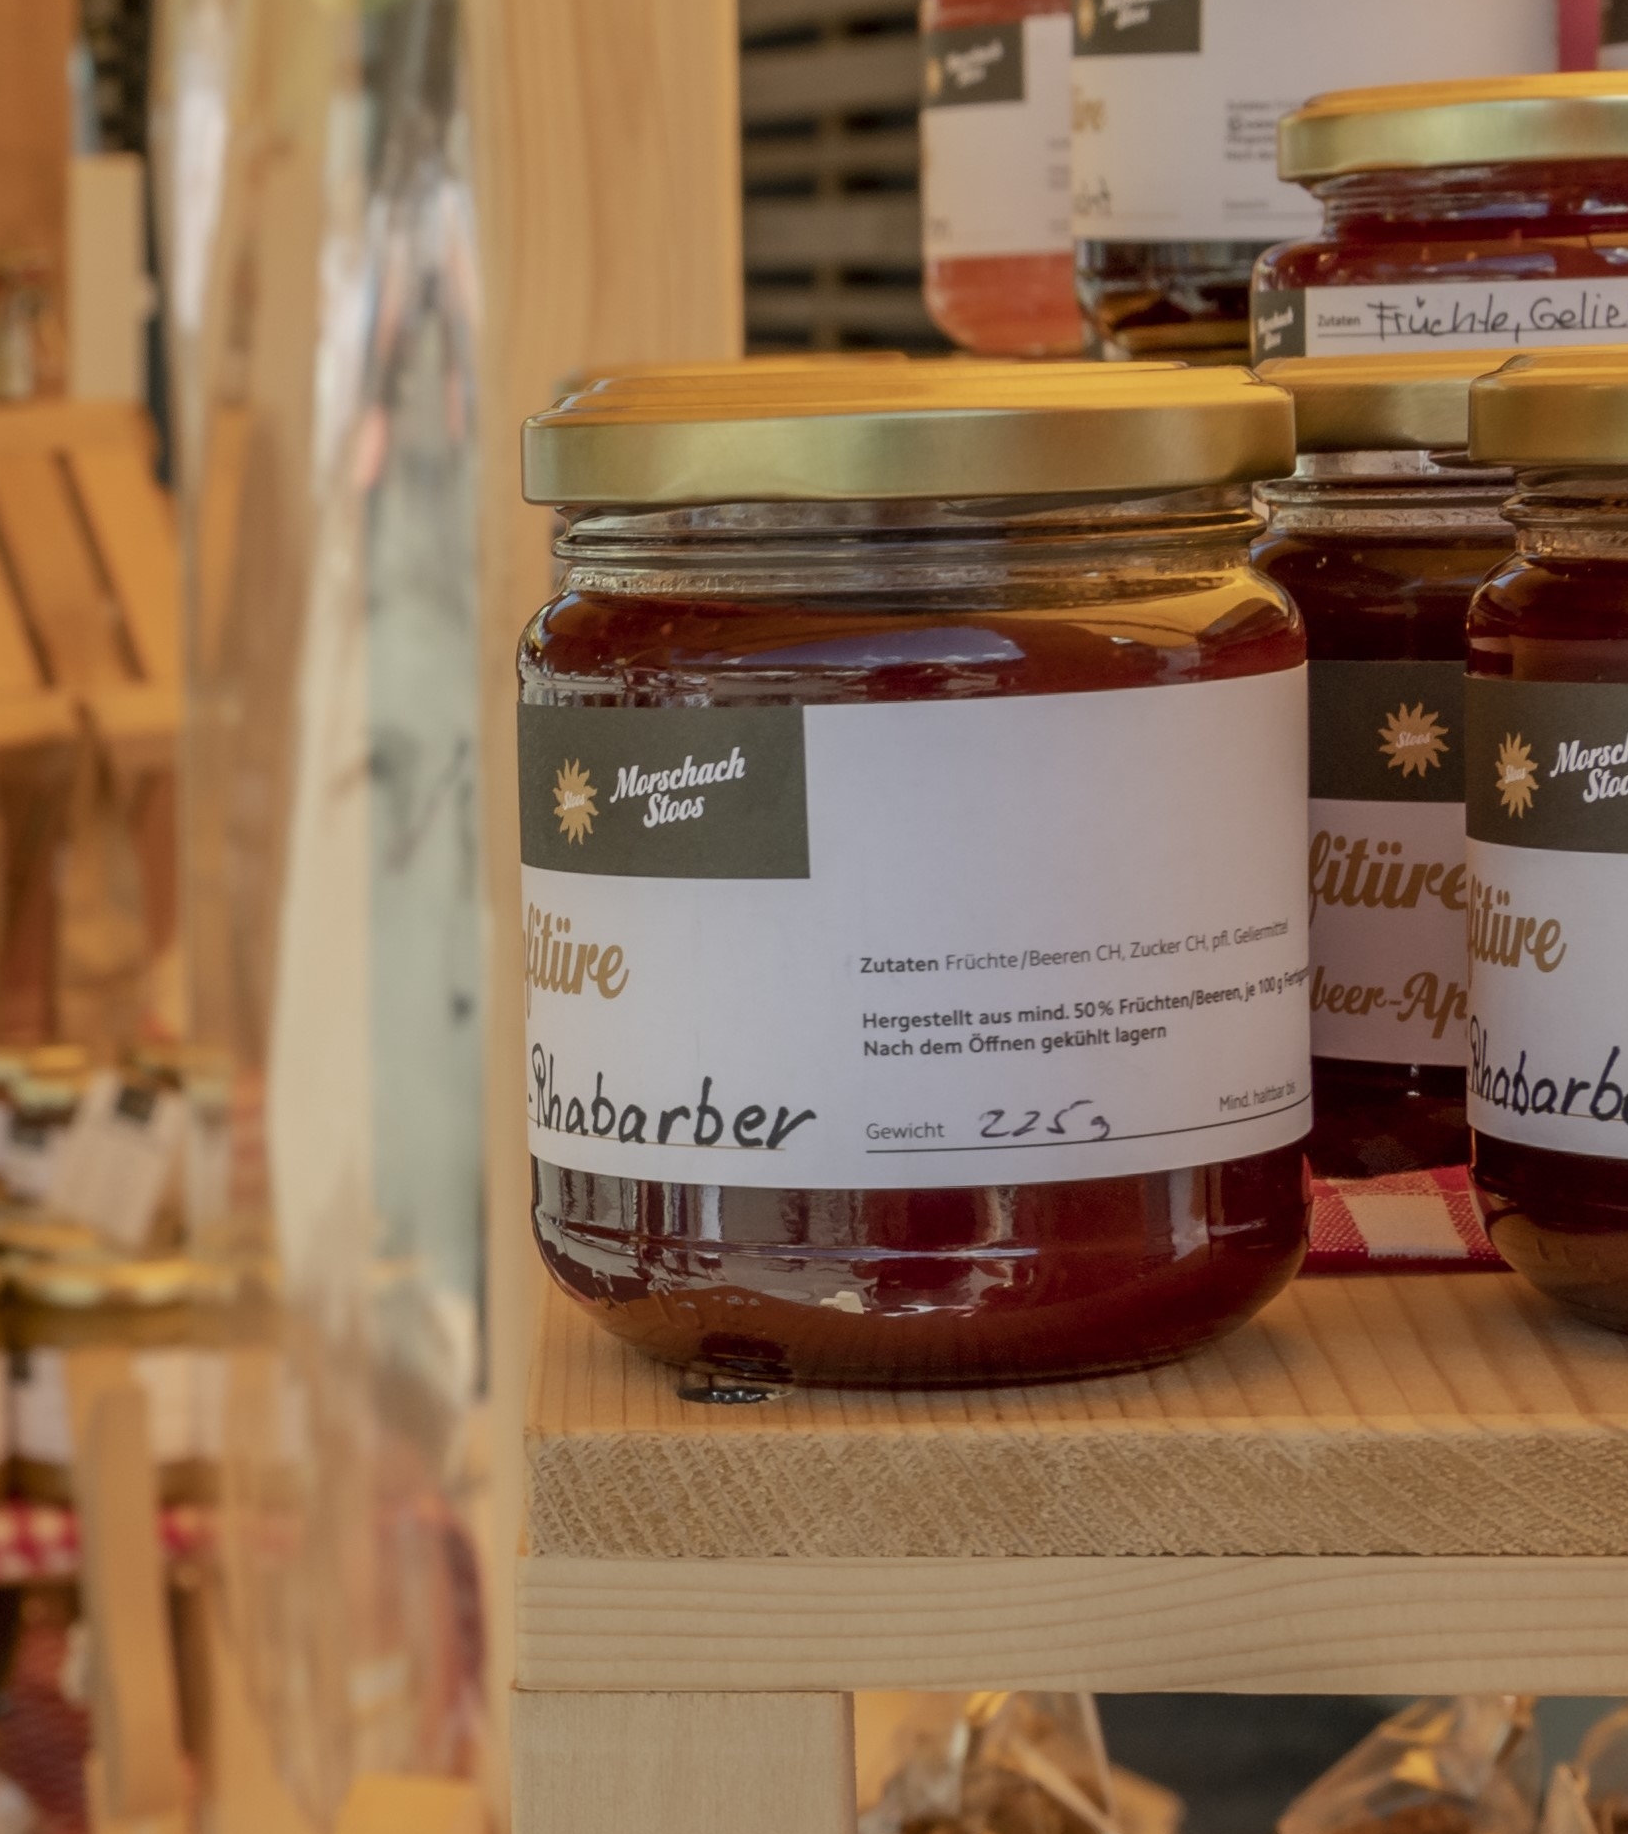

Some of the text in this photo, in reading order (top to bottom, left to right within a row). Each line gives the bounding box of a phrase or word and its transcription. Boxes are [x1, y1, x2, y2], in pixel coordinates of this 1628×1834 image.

[1317, 315, 1361, 328] Zutaten
[609, 747, 747, 804] Morschach
[643, 792, 705, 829] Stoos
[860, 919, 1288, 973] Zutaten Früchte/Beeren CH, Zucker CH, pfl. Geliermittel
[863, 1010, 972, 1031] Hergestellt
[979, 1012, 1011, 1025] aus
[1018, 1004, 1069, 1023] mind.
[1120, 984, 1242, 1014] Früchten/Beeren,
[1245, 983, 1255, 1002] je
[1259, 977, 1275, 994] 100
[1277, 978, 1283, 994] g
[864, 1025, 1166, 1056] Nach dem Öffnen gekühlt lagern
[866, 1122, 945, 1139] Gewicht
[1220, 1092, 1249, 1112] Mind.
[1254, 1084, 1284, 1105] haltbar
[1286, 1080, 1296, 1096] bis
